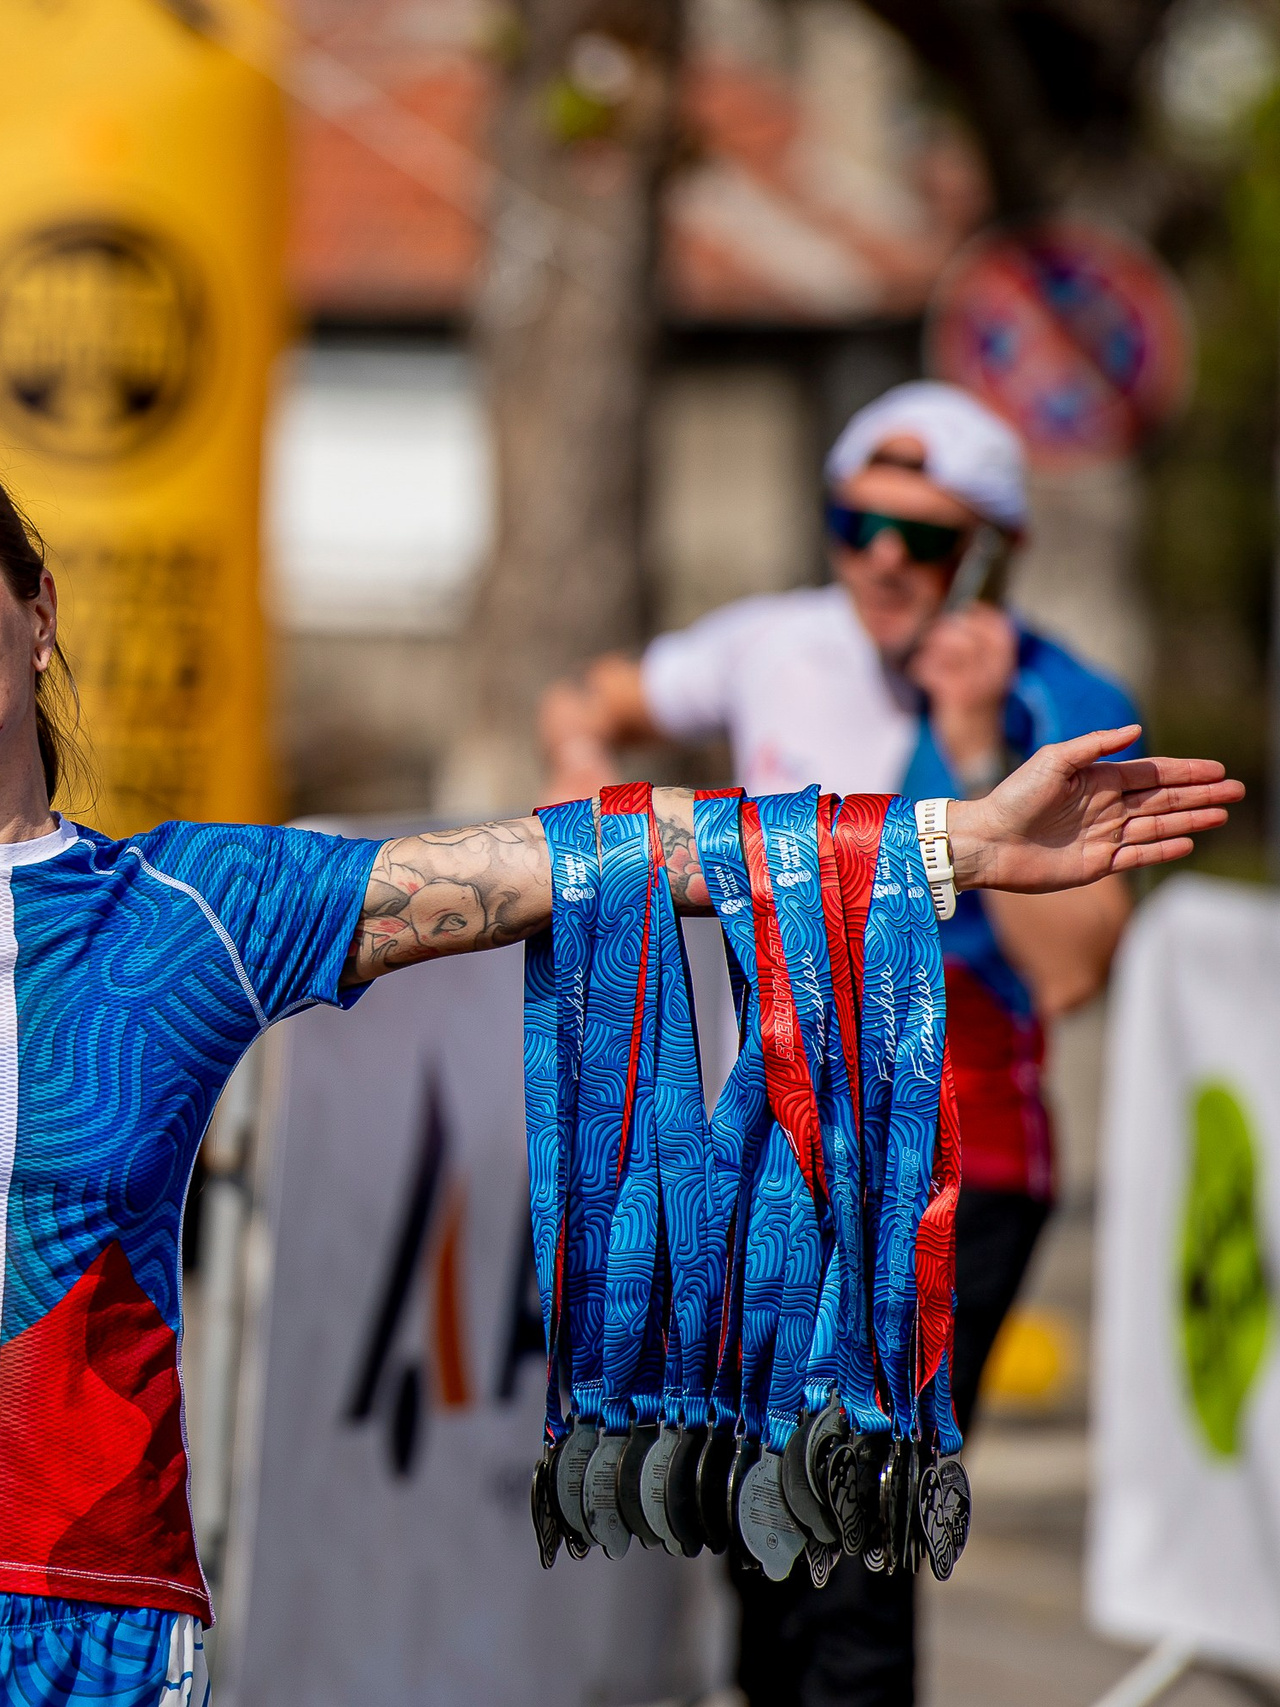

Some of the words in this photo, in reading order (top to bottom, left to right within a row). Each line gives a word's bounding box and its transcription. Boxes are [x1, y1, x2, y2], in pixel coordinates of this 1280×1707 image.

[713, 866, 732, 898] PLOVDIV
[726, 873, 740, 895] HILLS
[770, 967, 795, 1062] MATTERS
[869, 963, 896, 1083] Finisher
[909, 965, 936, 1085] Finisher
[896, 1146, 921, 1239] MATTERS
[888, 1238, 911, 1290] STEP
[886, 1289, 905, 1350] EVERY
